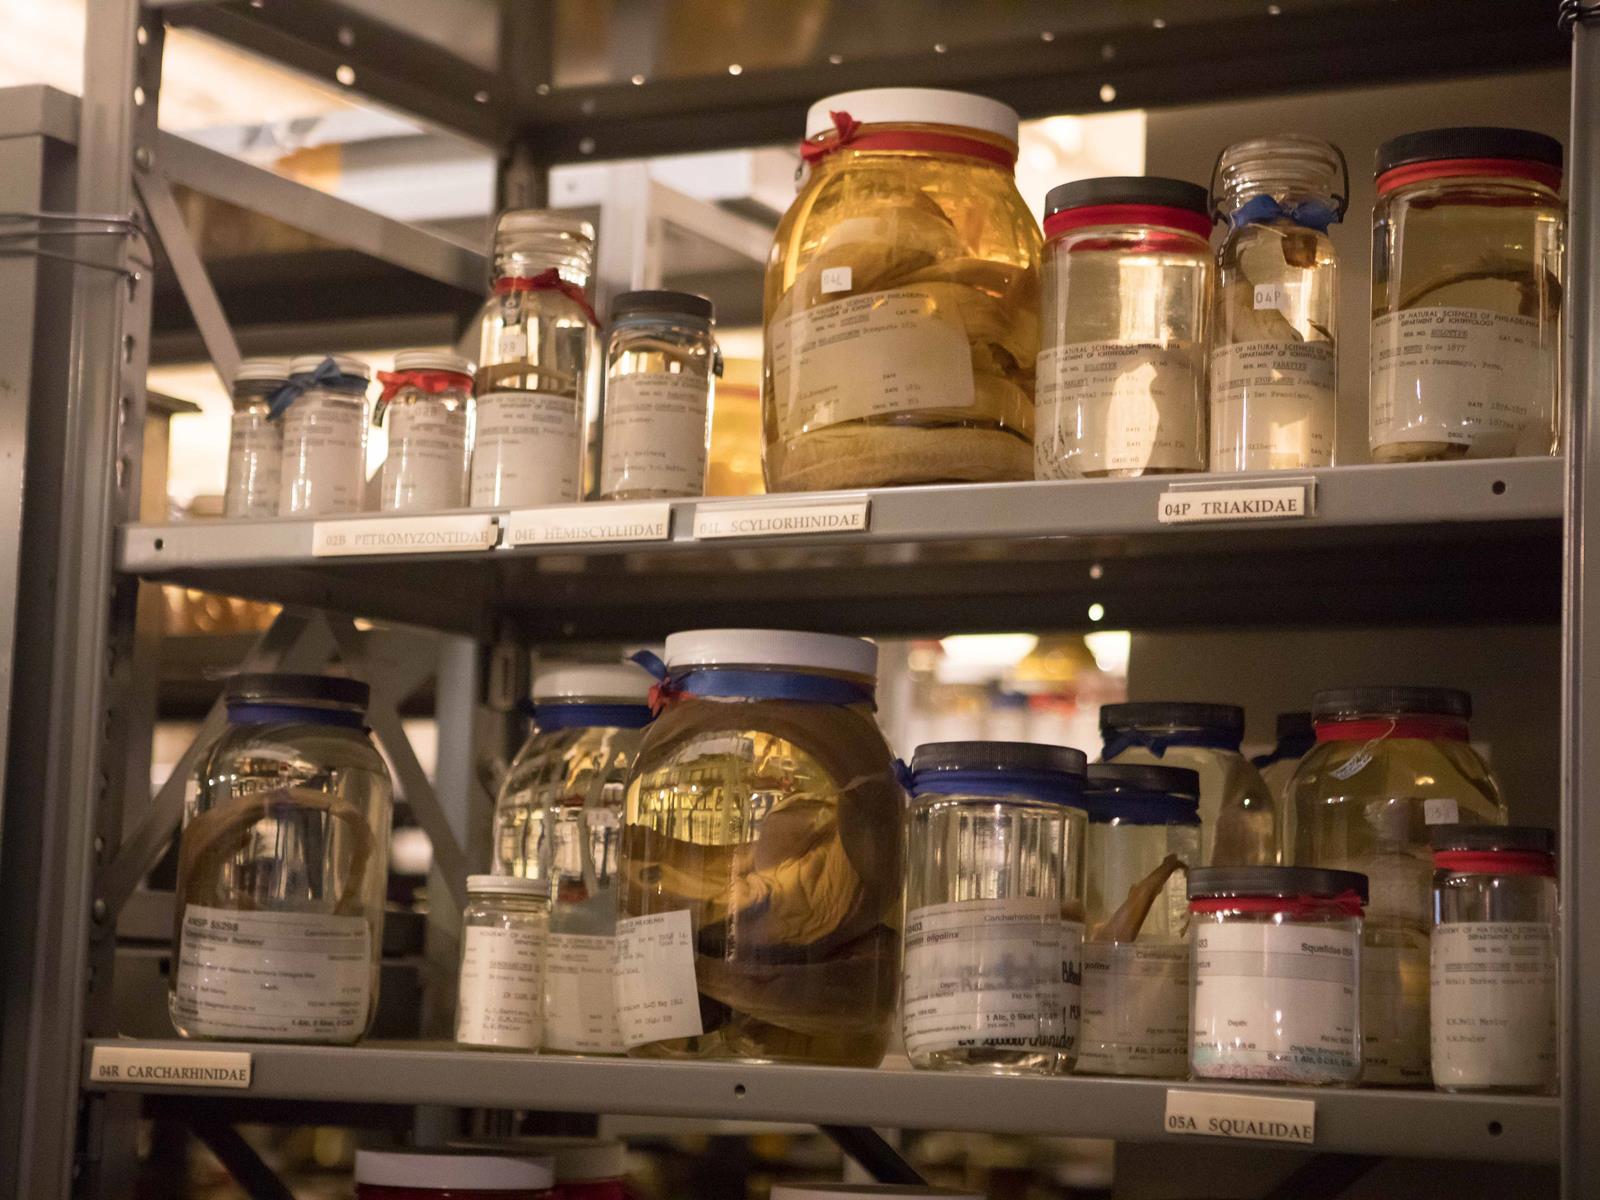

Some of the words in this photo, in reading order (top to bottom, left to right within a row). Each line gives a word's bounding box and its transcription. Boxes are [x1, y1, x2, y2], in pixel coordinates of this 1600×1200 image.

[1255, 291, 1281, 304] 04P
[1408, 311, 1438, 320] NATURAL
[1442, 310, 1478, 318] SCIENCES
[1246, 344, 1278, 352] NATURAL
[1164, 502, 1191, 516] 04P
[1201, 500, 1297, 516] TRIAKIDAE
[730, 514, 860, 532] SCYLIORHINIDAE
[326, 534, 346, 546] 02B
[354, 530, 488, 546] PETROMYZONTIDAE
[514, 529, 536, 541] 04E
[544, 524, 664, 540] HEMISCYLLIIDAE
[1301, 943, 1341, 956] Squalidae
[99, 1064, 119, 1077] 04R
[127, 1065, 247, 1081] CARCHARHINIDAE
[1169, 1116, 1198, 1130] 05A
[1208, 1118, 1312, 1139] SQUALIDAE
